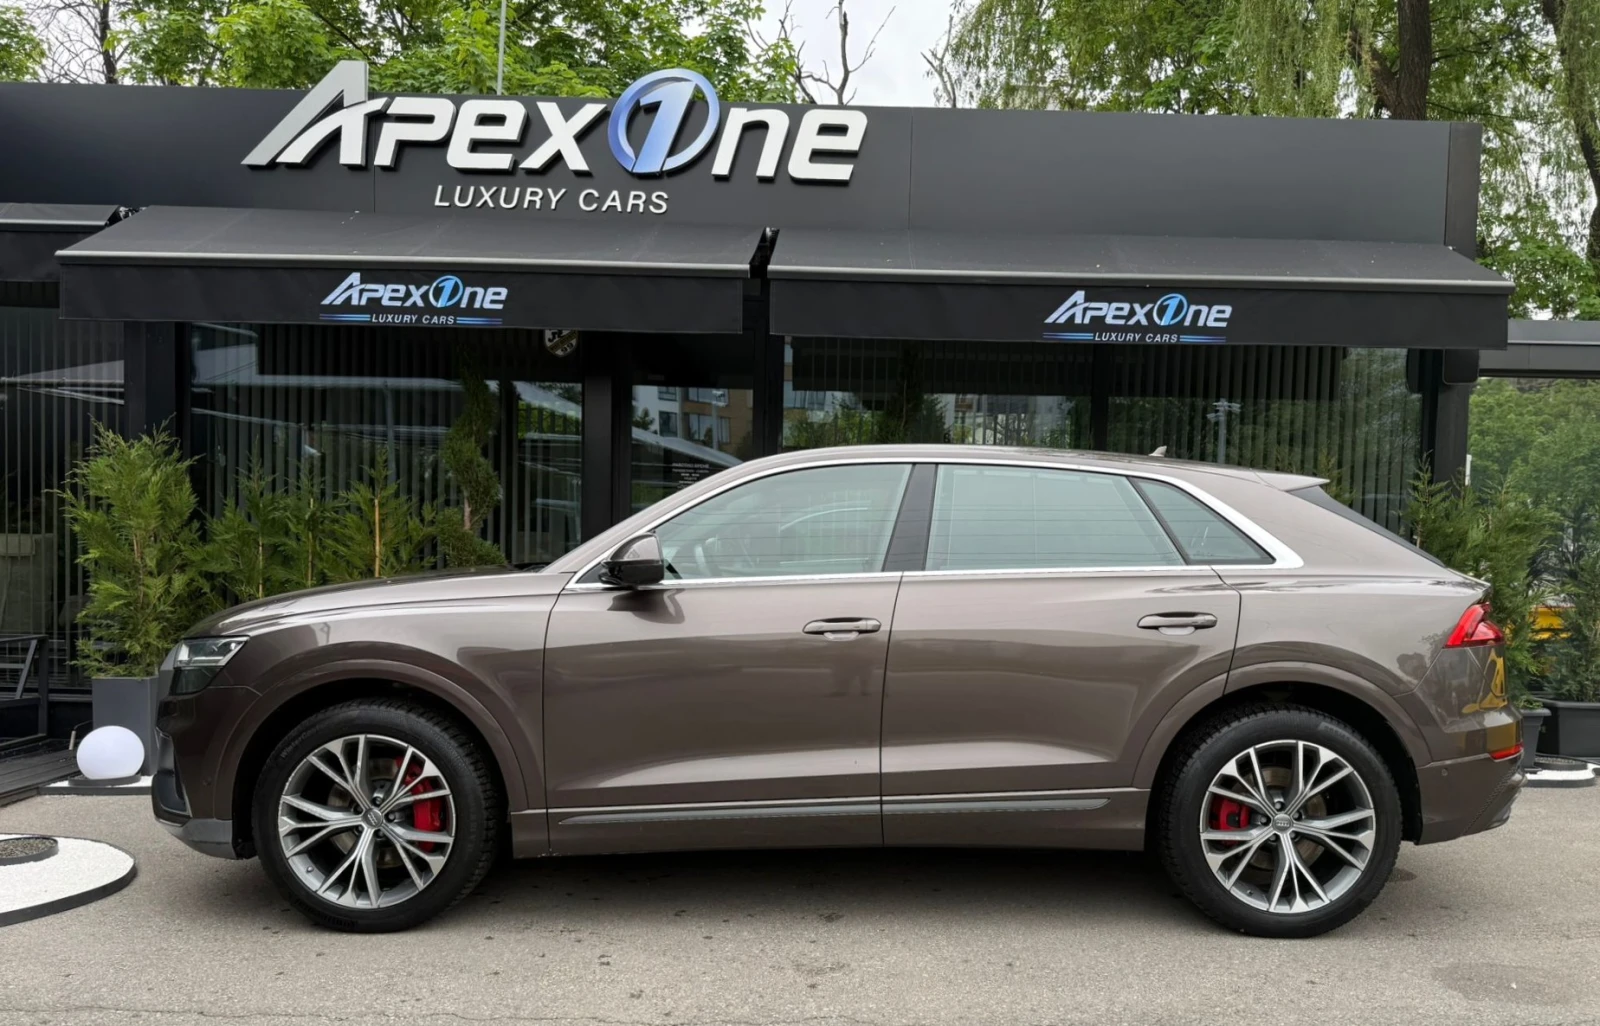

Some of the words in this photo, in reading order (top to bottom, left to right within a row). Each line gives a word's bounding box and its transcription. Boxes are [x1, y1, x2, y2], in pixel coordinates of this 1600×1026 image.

[434, 185, 566, 211] LUXURY
[578, 189, 669, 215] CARS
[371, 313, 417, 324] LUXURY
[422, 314, 455, 325] CARS
[1094, 332, 1141, 342] LUXURY
[1145, 333, 1178, 343] CARS
